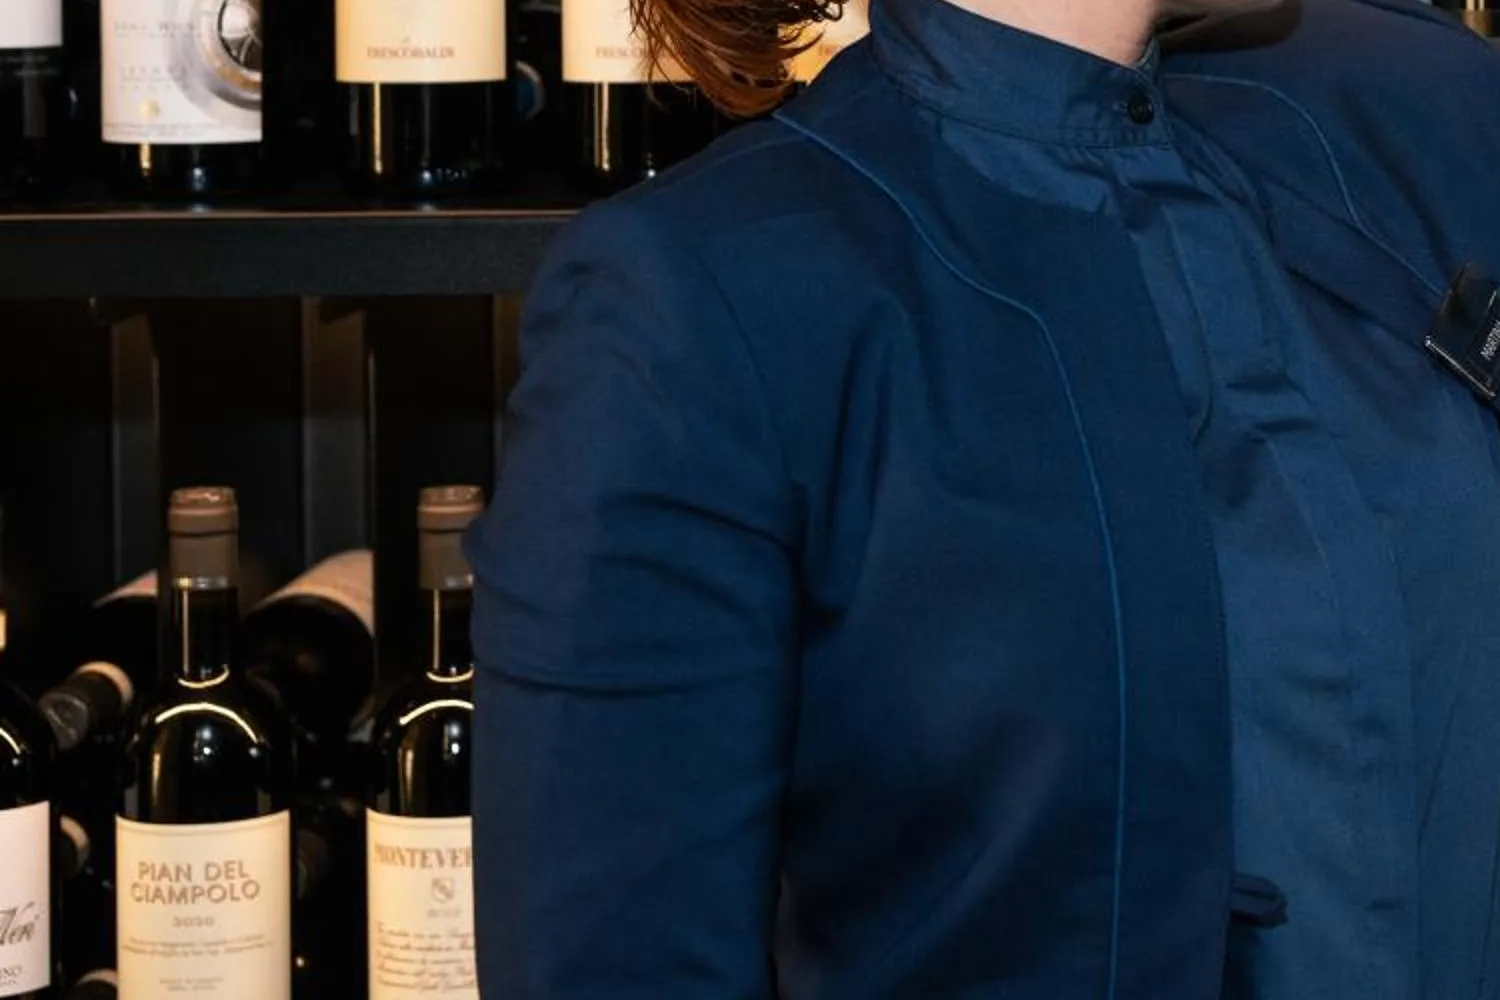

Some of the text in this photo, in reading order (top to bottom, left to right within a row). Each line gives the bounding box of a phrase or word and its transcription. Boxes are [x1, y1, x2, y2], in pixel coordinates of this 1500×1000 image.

[137, 859, 250, 883] PIAN DEL
[130, 879, 261, 905] CIAMPOLO
